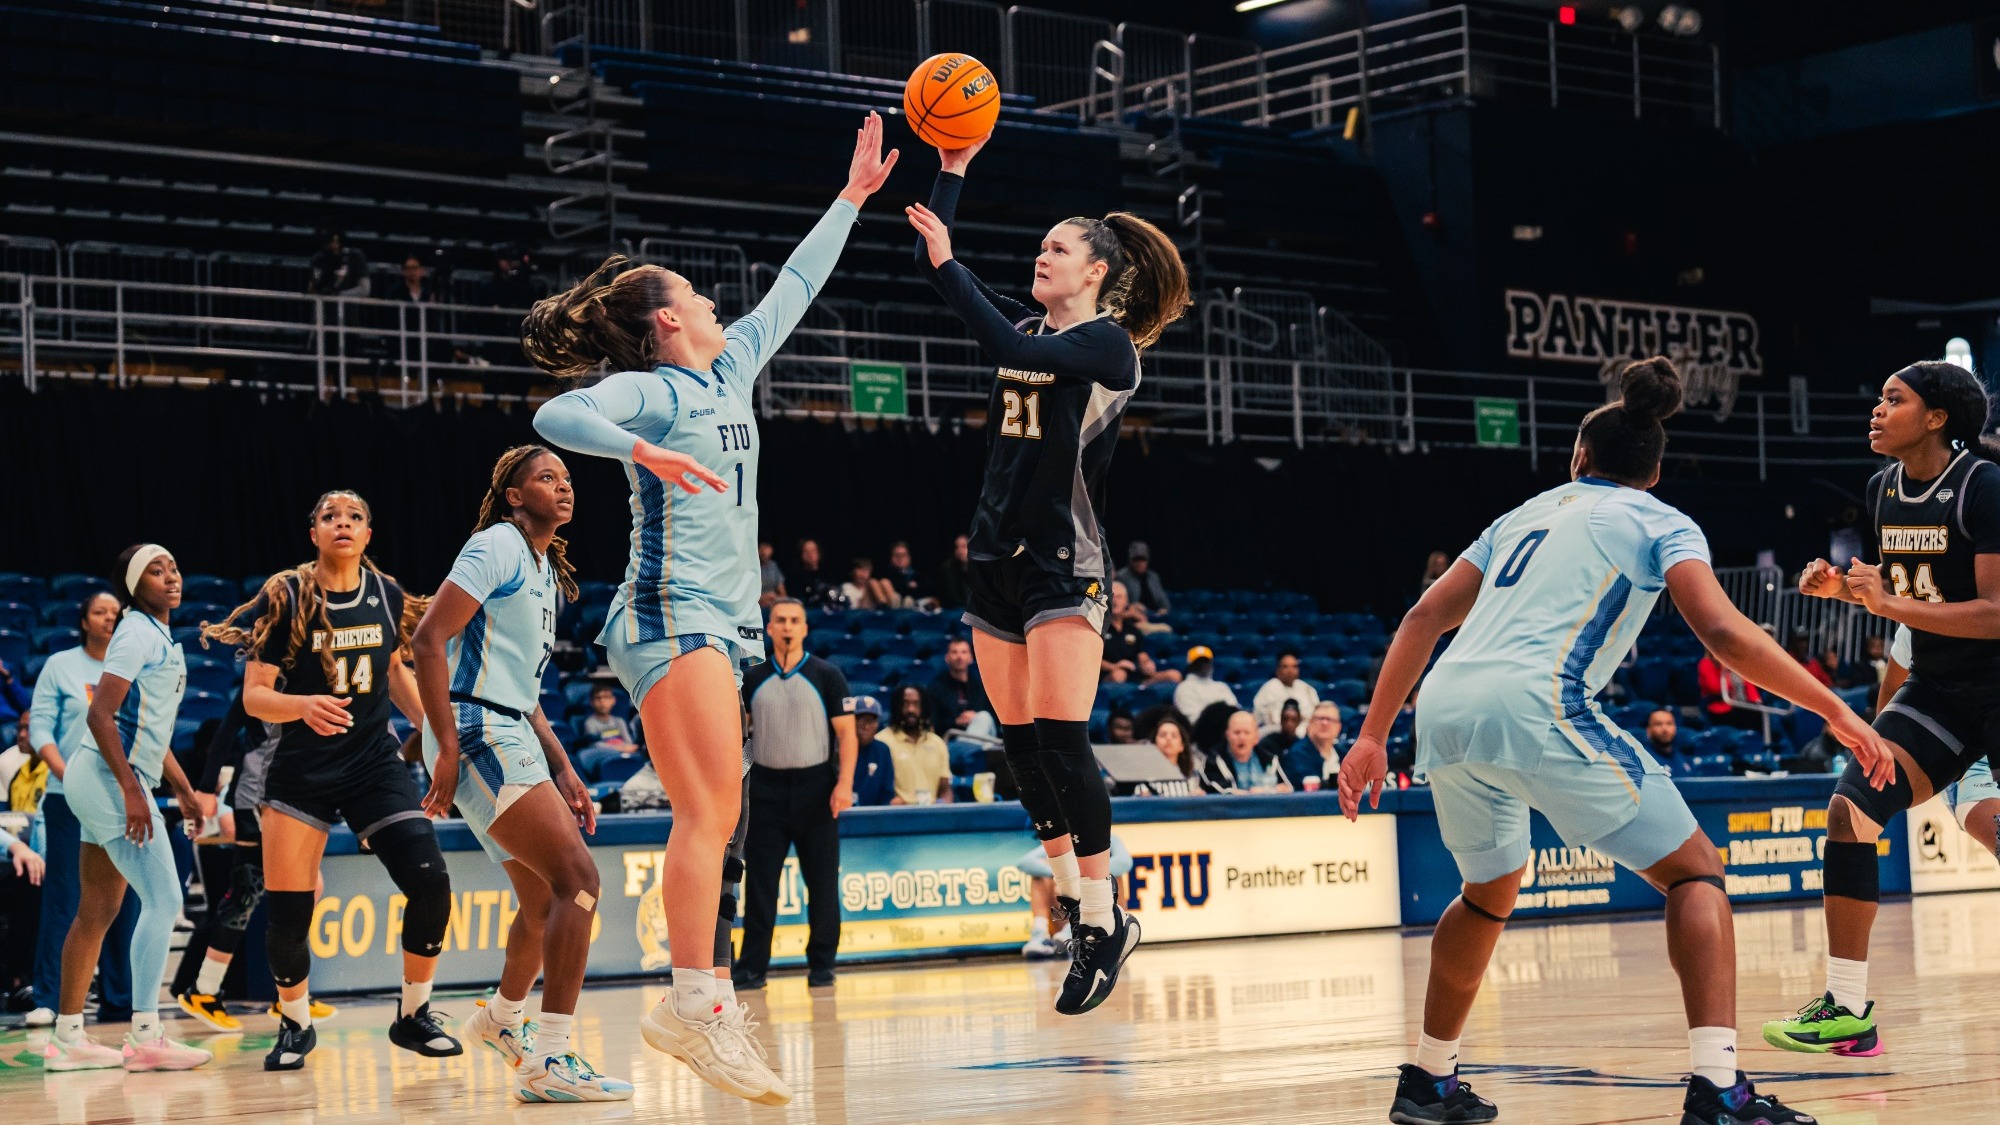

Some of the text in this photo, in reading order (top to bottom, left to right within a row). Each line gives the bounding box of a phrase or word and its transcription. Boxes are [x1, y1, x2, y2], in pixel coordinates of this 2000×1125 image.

[961, 72, 995, 101] NCAA
[1505, 289, 1762, 376] PANTHER
[1001, 389, 1042, 440] 21
[717, 423, 751, 452] FIU
[735, 462, 743, 507] 1
[1494, 528, 1550, 588] 0
[1881, 525, 1948, 554] RETRIEVERS
[1890, 562, 1946, 603] 24
[333, 654, 374, 695] 14
[1771, 806, 1804, 833] FIU
[1729, 836, 1814, 866] PANTHER
[1126, 851, 1211, 911] FIU
[1226, 861, 1369, 889] Panther TECH
[309, 895, 375, 958] GO
